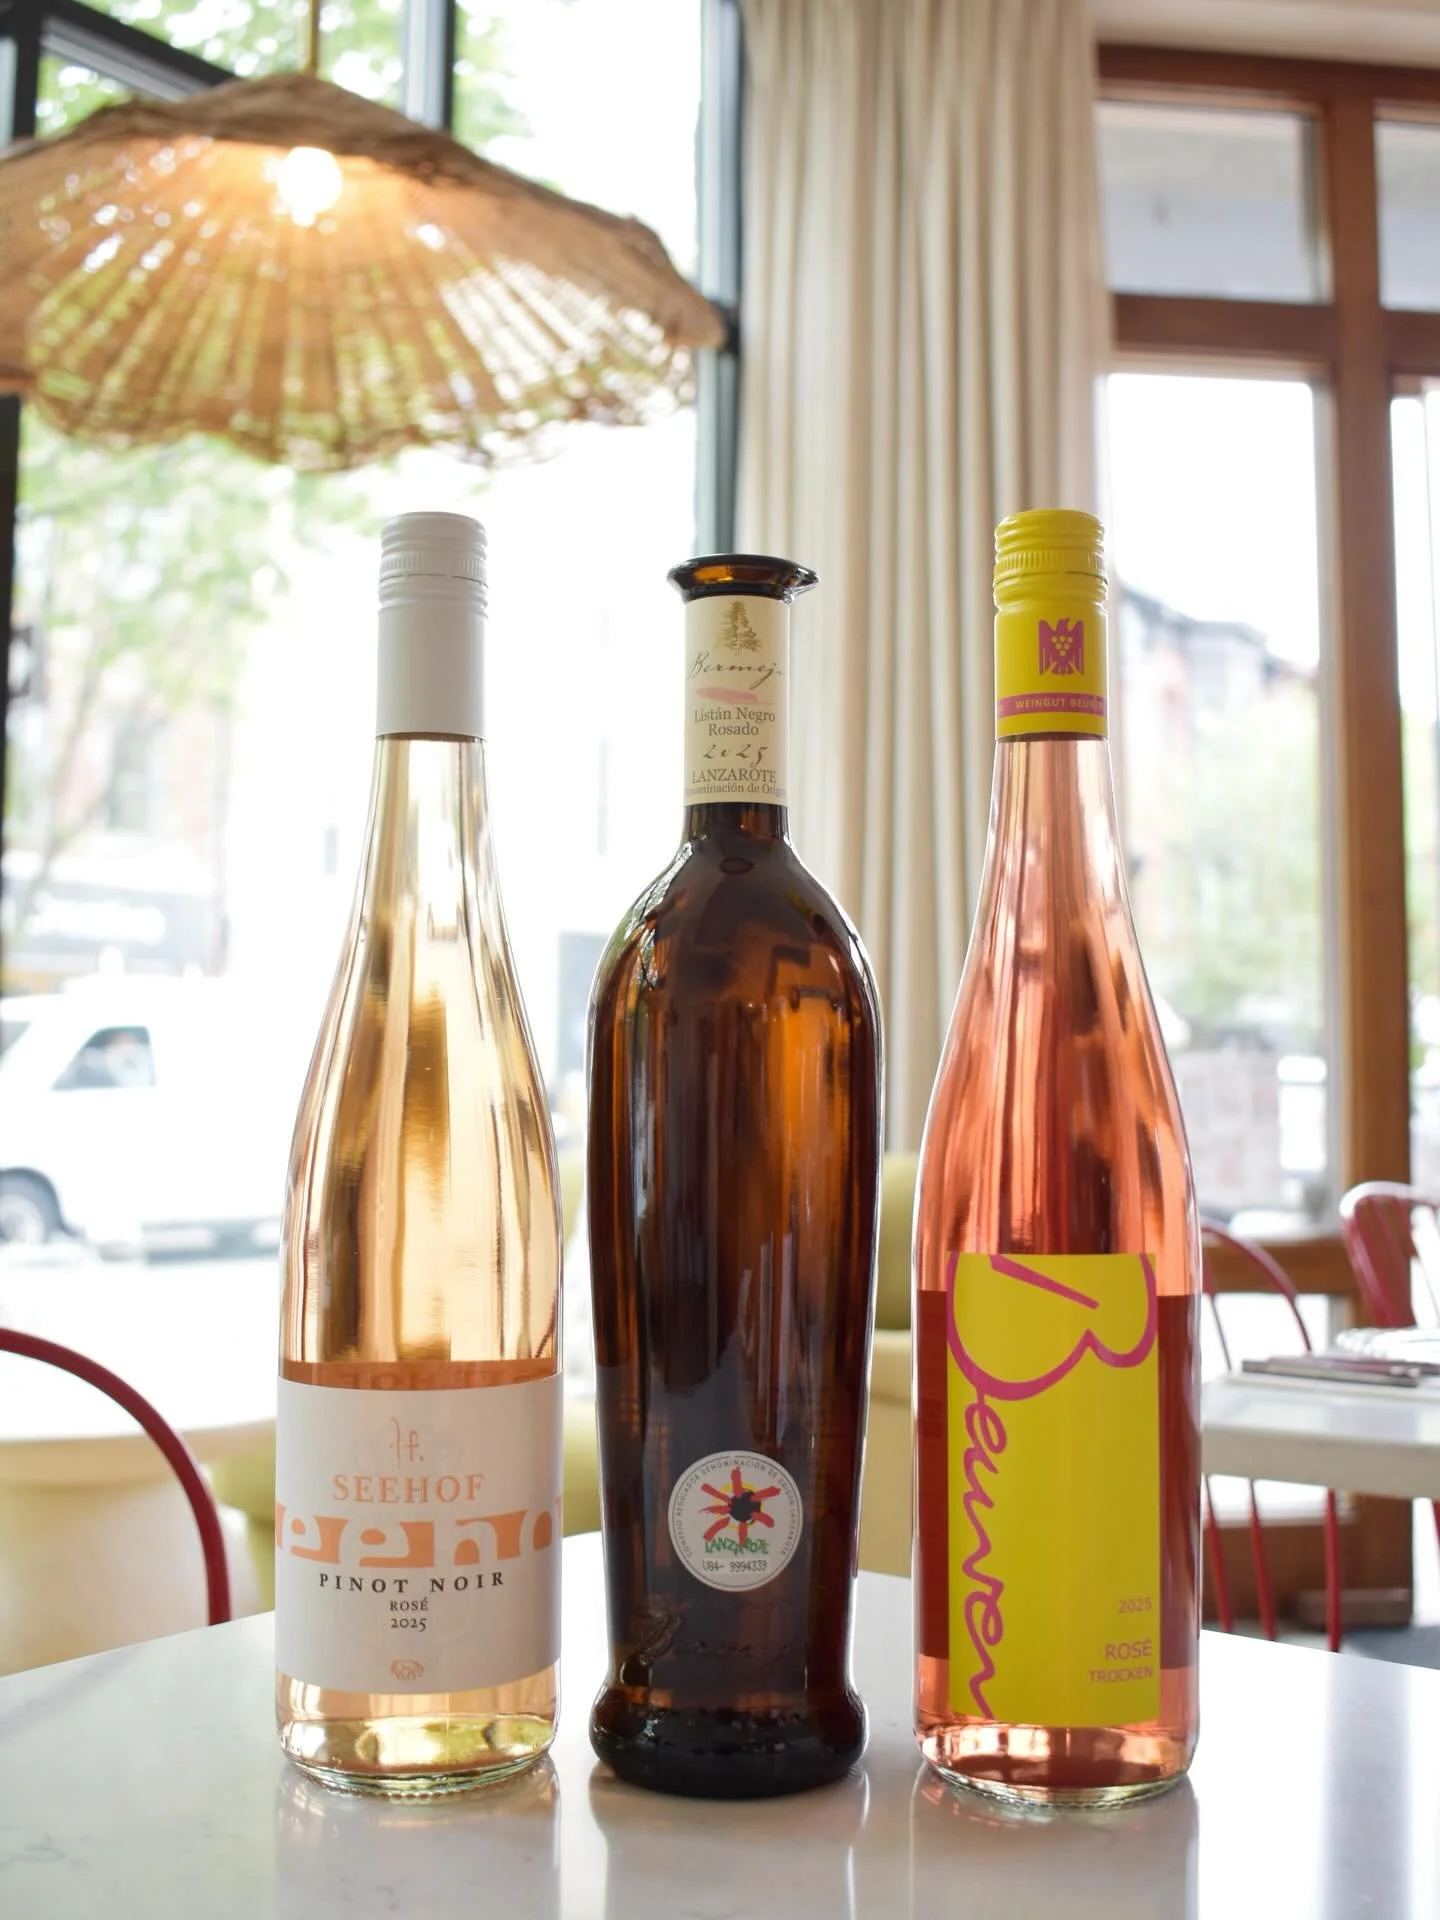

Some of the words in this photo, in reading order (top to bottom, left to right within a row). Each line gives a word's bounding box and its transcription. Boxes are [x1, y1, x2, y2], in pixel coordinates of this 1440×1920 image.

[1015, 697, 1066, 710] WEINGUT
[694, 707, 732, 723] Listán
[736, 707, 776, 724] Negro
[708, 721, 759, 737] Rosado
[692, 768, 777, 785] LANZAROTE
[747, 782, 760, 793] de
[332, 1473, 485, 1504] SEEHOF
[319, 1572, 408, 1594] PINOT
[430, 1571, 504, 1593] NOIR
[389, 1597, 429, 1612] ROSÉ
[1117, 1596, 1153, 1614] 2025
[391, 1617, 427, 1632] 2025
[1104, 1636, 1153, 1661] ROSÉ
[1088, 1665, 1153, 1683] TROCKEN
